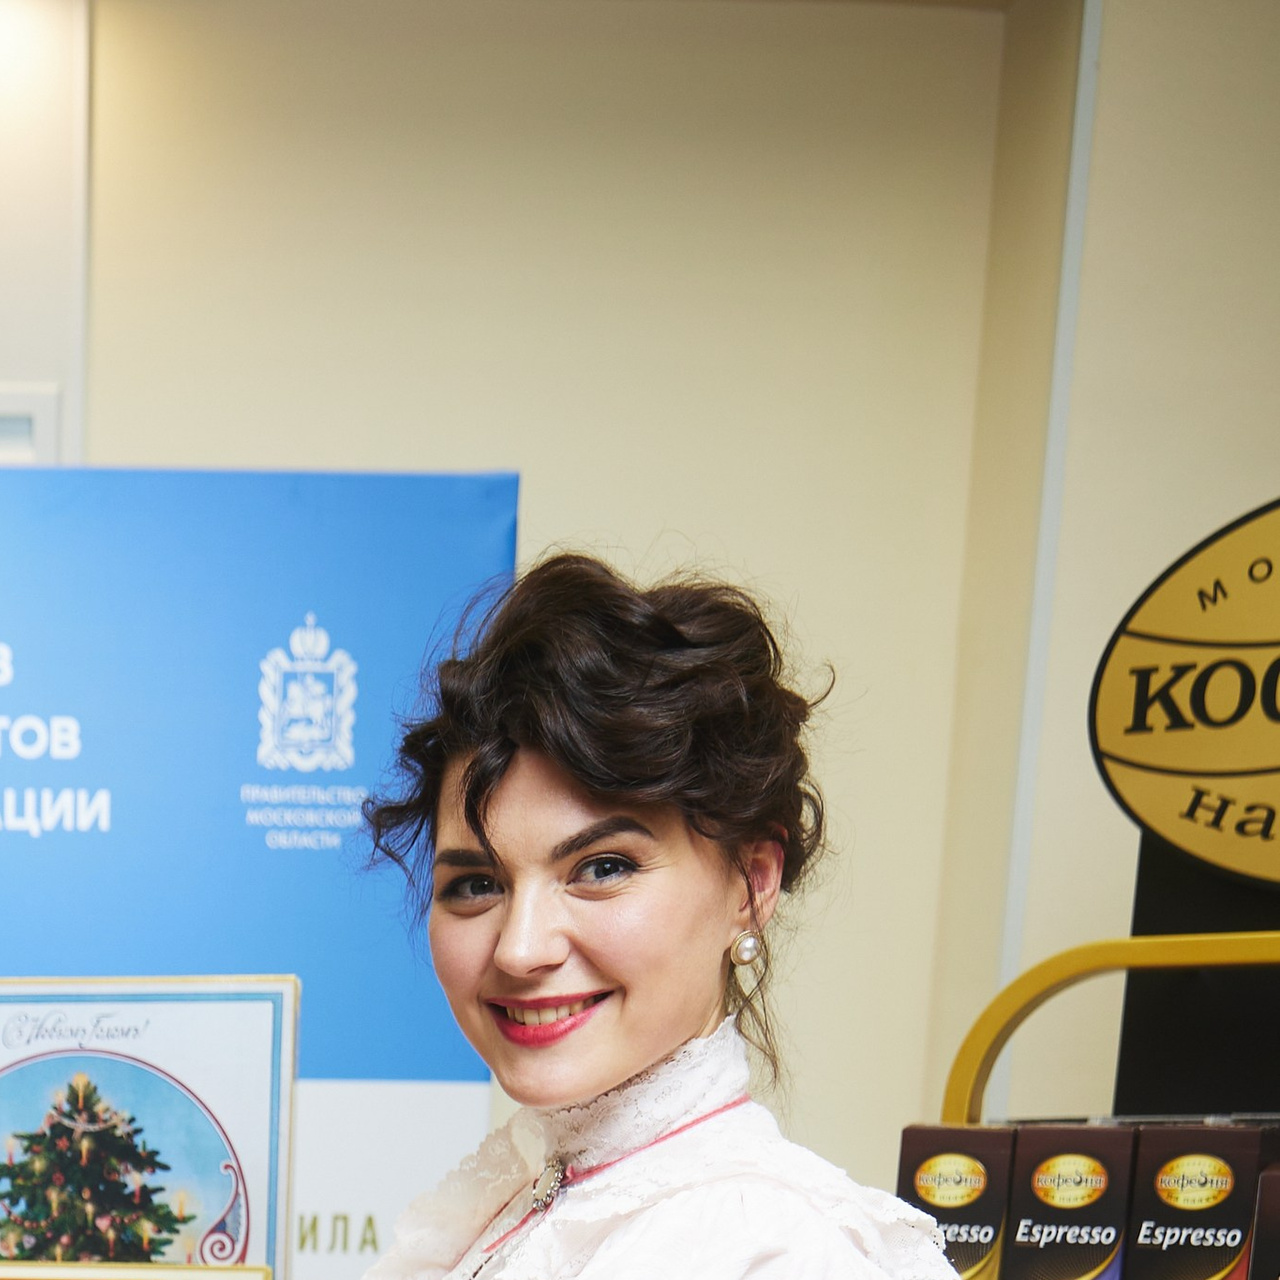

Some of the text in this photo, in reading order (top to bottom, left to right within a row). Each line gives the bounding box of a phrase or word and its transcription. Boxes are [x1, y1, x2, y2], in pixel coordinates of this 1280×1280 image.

[1197, 557, 1273, 612] МО
[298, 1214, 378, 1253] ИЛА
[1015, 1218, 1117, 1249] Espresso
[1137, 1220, 1242, 1250] Espresso
